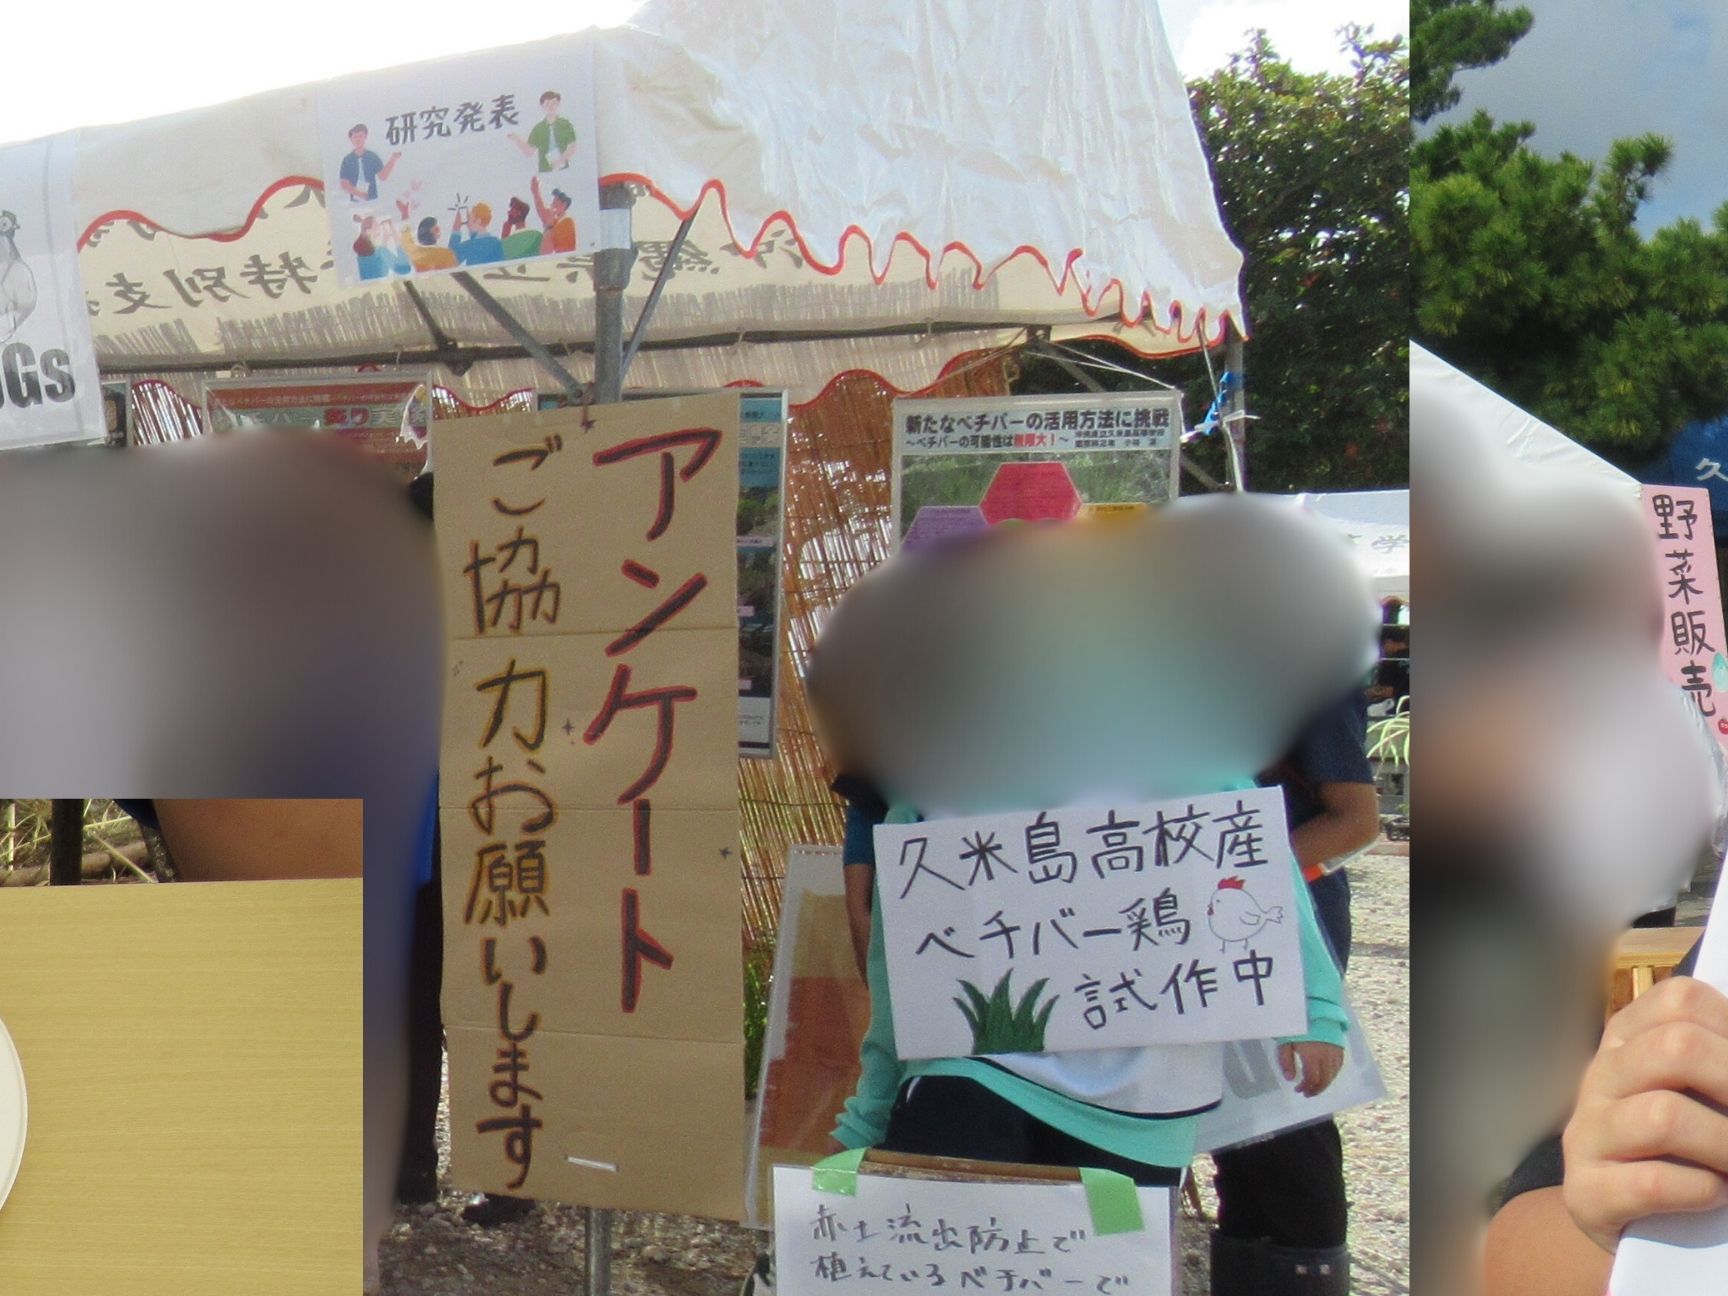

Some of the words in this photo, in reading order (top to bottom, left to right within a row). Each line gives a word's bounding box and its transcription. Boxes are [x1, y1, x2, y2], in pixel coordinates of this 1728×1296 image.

[384, 93, 522, 147] 研究発表
[905, 407, 1170, 435] 新たなベチバーの活用方法に挑戦
[1652, 493, 1716, 718] 野菜販売
[583, 427, 724, 1014] アンケート
[461, 433, 563, 1191] ご協力お願いします
[898, 800, 1270, 900] 久米島高校産
[915, 887, 1193, 960] ベチバー鶏
[1073, 948, 1275, 1031] 試作中
[810, 1204, 1086, 1255] 赤土流出防止で
